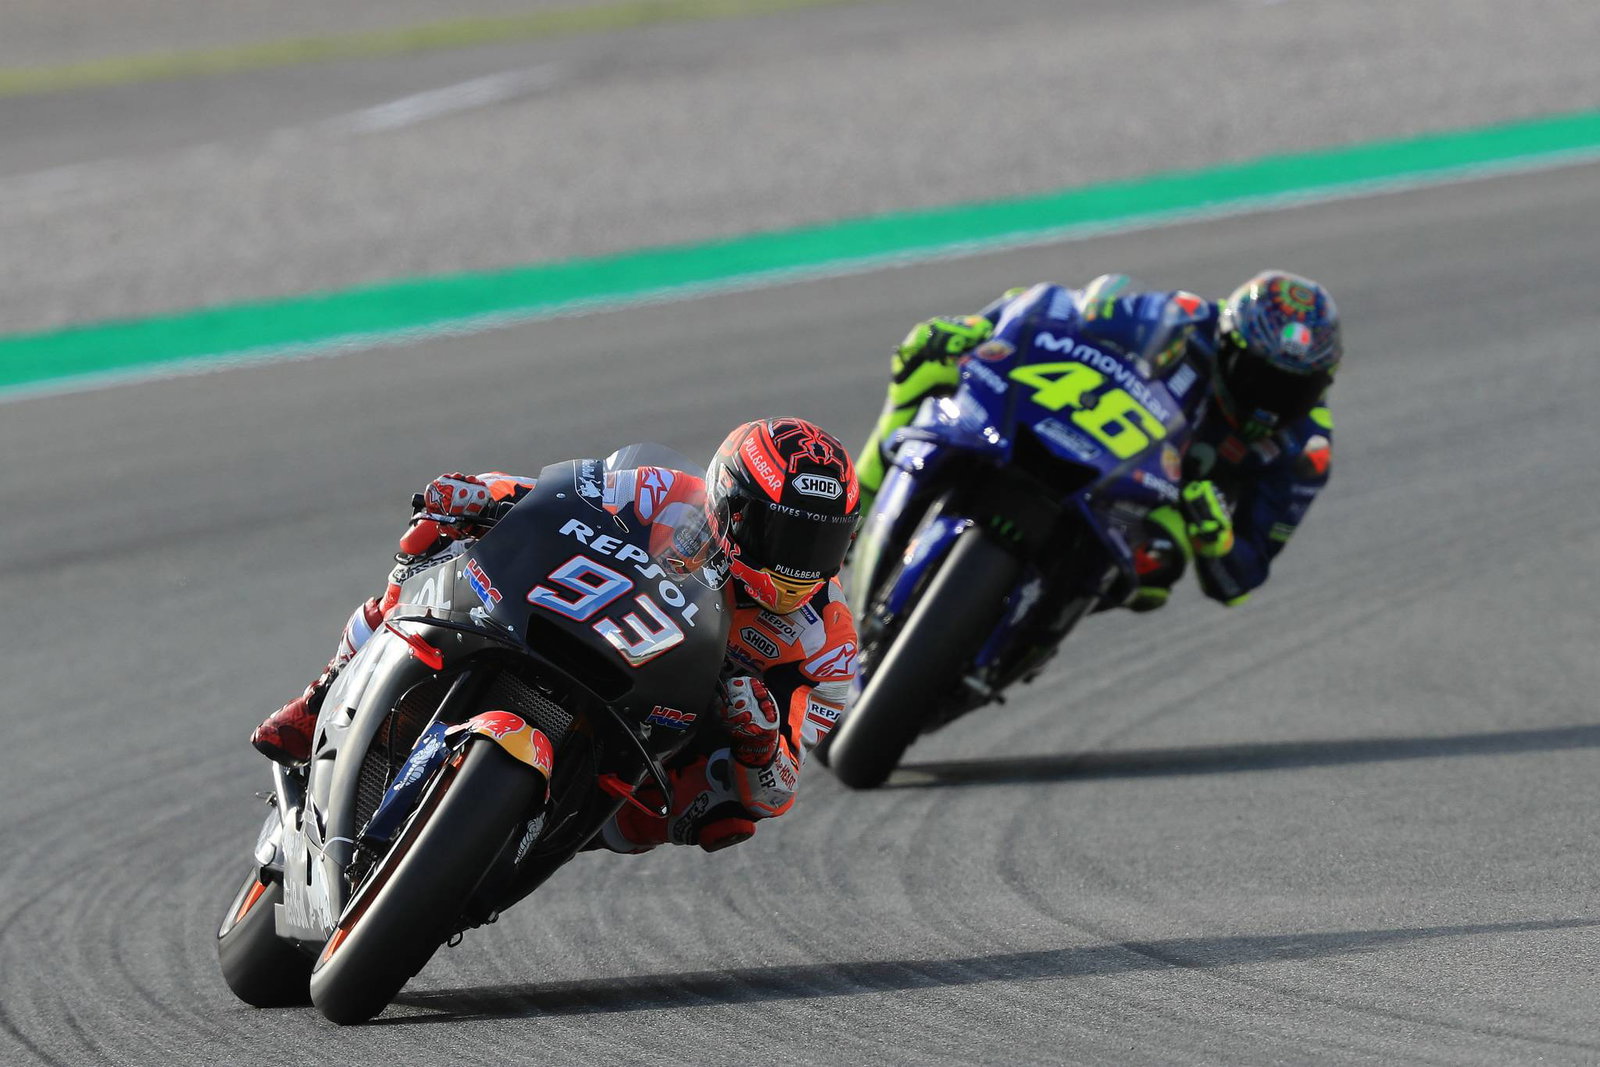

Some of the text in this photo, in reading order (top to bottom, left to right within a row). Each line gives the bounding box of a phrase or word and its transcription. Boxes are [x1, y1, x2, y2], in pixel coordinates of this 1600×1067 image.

[1071, 343, 1171, 422] movistar
[1008, 361, 1168, 460] 46
[744, 437, 782, 491] PULL&BEAR
[801, 478, 837, 496] SHOEI
[769, 503, 800, 518] GIVES
[806, 511, 827, 523] YOU
[463, 558, 503, 613] HRC
[558, 518, 699, 628] REPSOL
[774, 564, 821, 579] PULL&BEAR
[527, 554, 685, 668] 93
[760, 610, 797, 638] REPSOL
[745, 629, 776, 657] SHOEI
[645, 705, 697, 730] HRC
[811, 703, 840, 720] REPS
